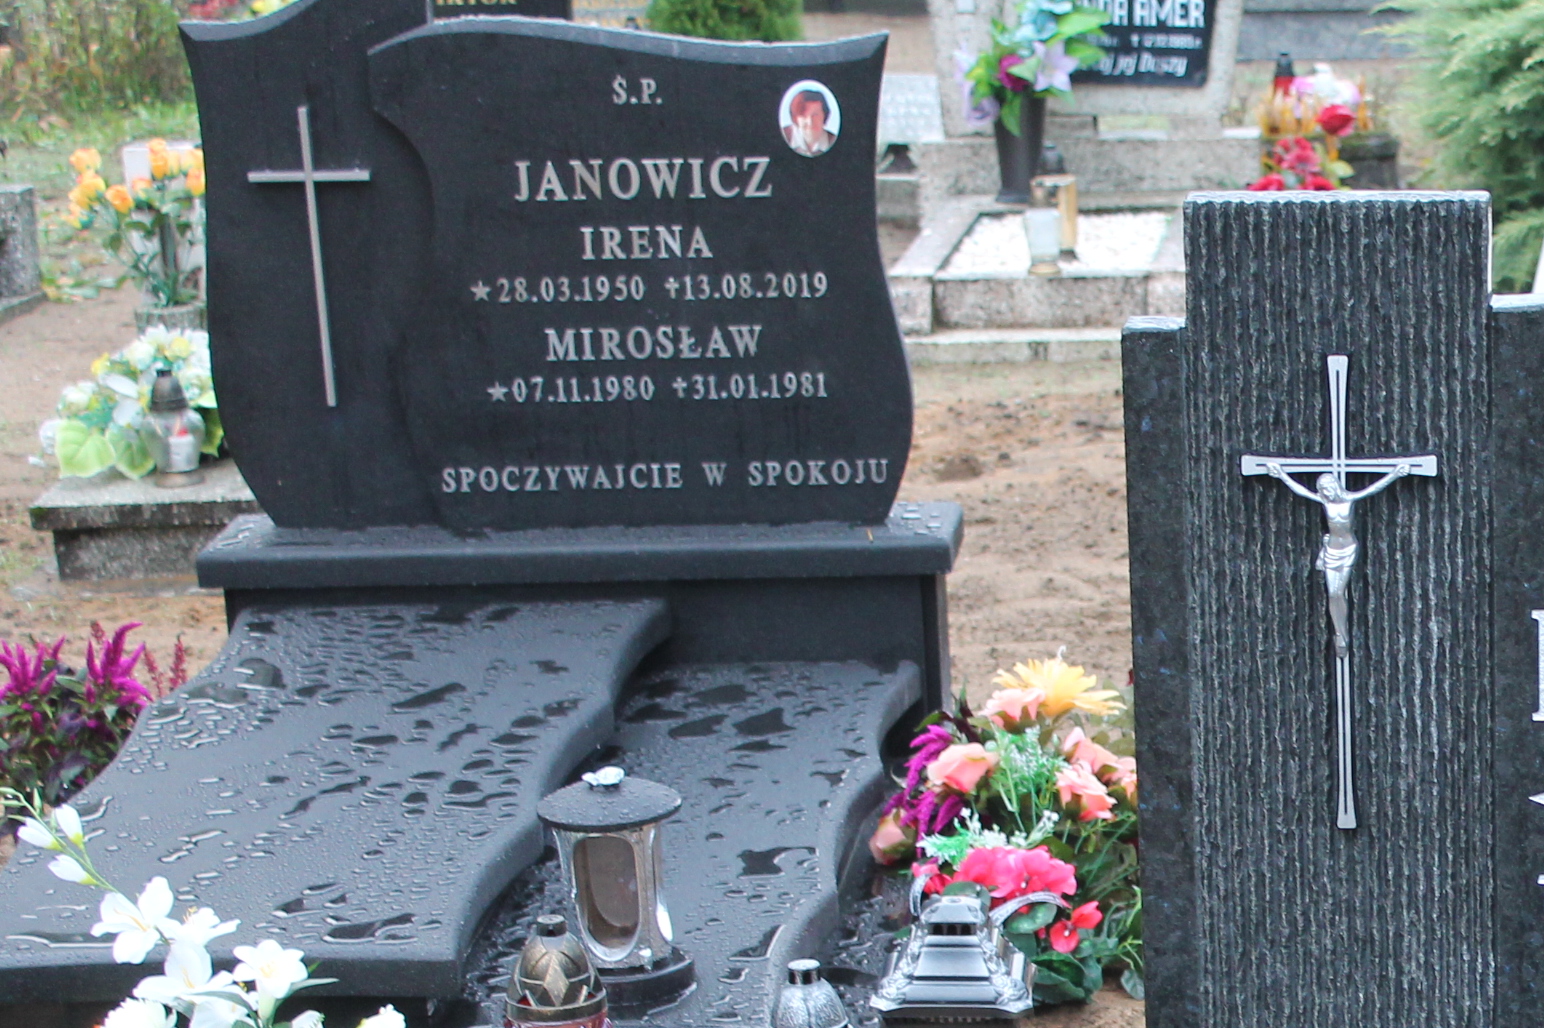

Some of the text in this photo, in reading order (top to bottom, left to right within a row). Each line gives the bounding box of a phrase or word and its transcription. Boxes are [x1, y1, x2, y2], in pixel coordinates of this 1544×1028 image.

[1133, 0, 1204, 27] AMER
[515, 156, 772, 201] JANOWICZ
[580, 225, 713, 259] IRENA
[497, 271, 827, 302] 28.03.1950 13.08.2019
[544, 324, 762, 361] MIROSŁAW
[511, 371, 827, 402] 07.11.1980 31.01.1981
[442, 458, 888, 493] SPOCZYWAJCIE W SPOKOJU
